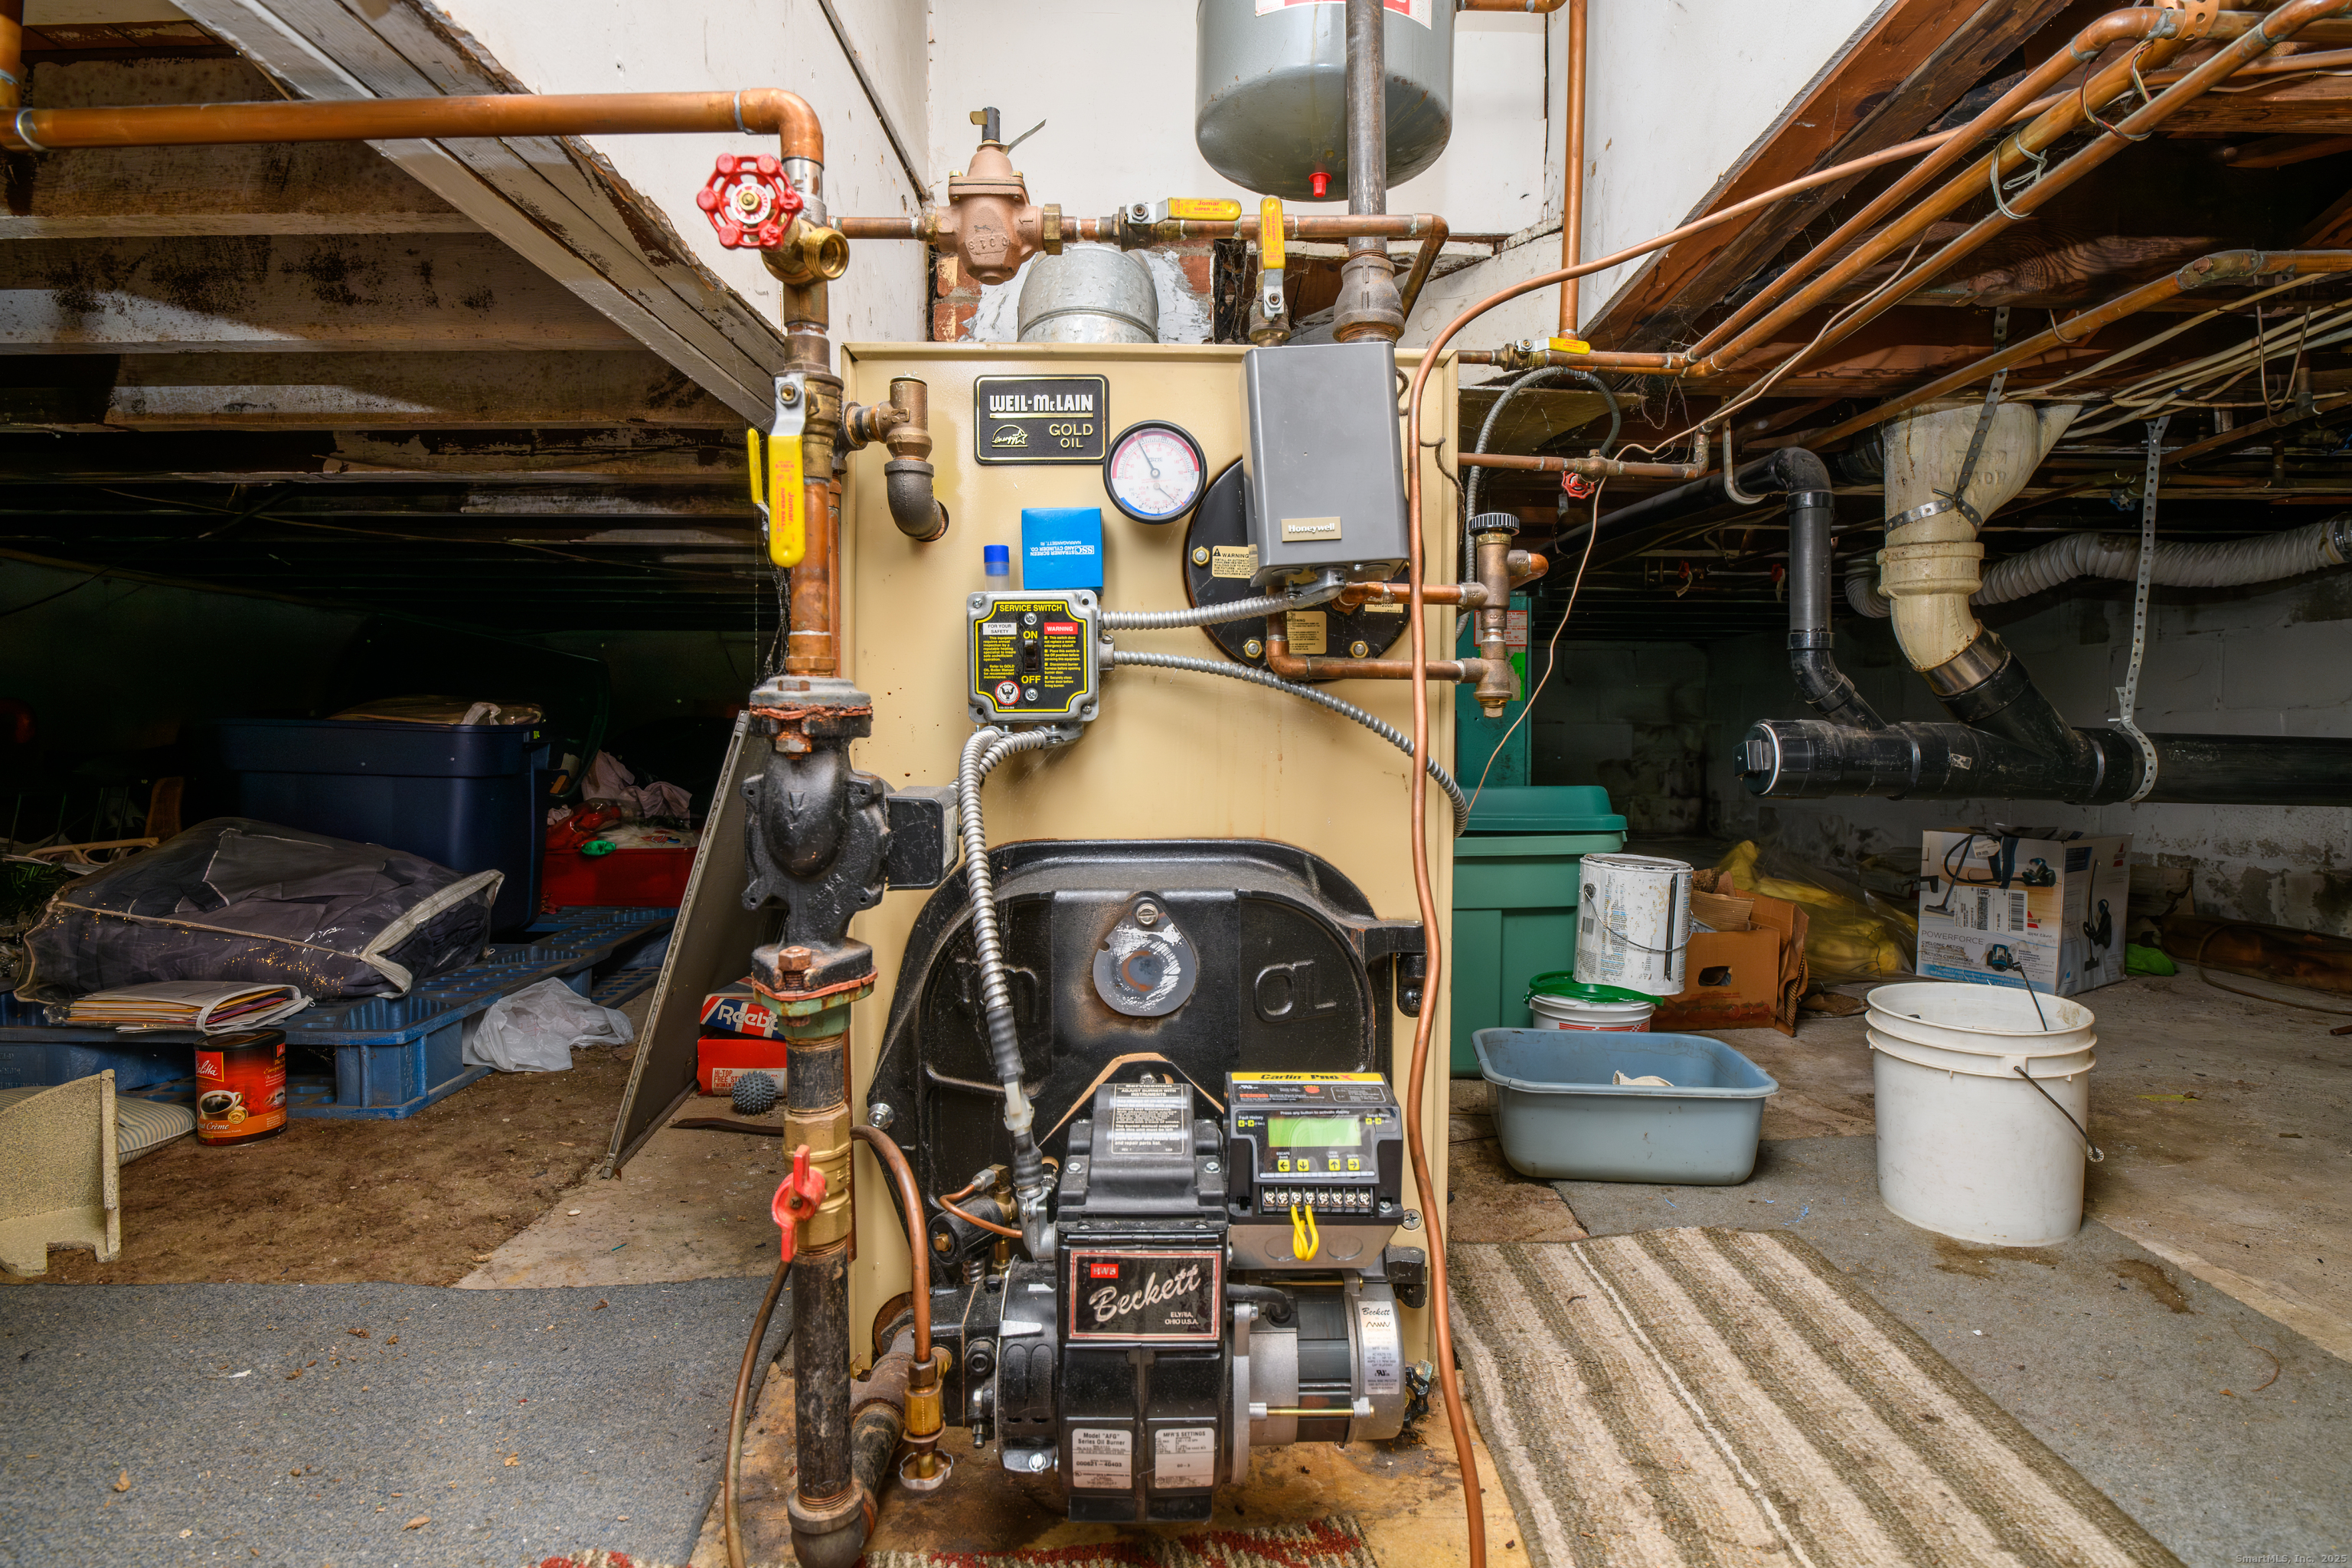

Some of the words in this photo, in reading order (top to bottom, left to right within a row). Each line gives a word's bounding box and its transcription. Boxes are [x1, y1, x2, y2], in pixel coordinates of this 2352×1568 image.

[1049, 423, 1093, 436] GOLD
[1060, 438, 1084, 449] OIL
[1288, 523, 1334, 533] Honeywell
[1023, 631, 1037, 639] ON
[1021, 675, 1041, 684] OFF
[1922, 929, 1984, 945] POWERFORCE
[1943, 954, 1974, 962] CYCLONIQUE
[718, 1004, 778, 1031] Reebo
[1089, 1264, 1200, 1322] Beckett
